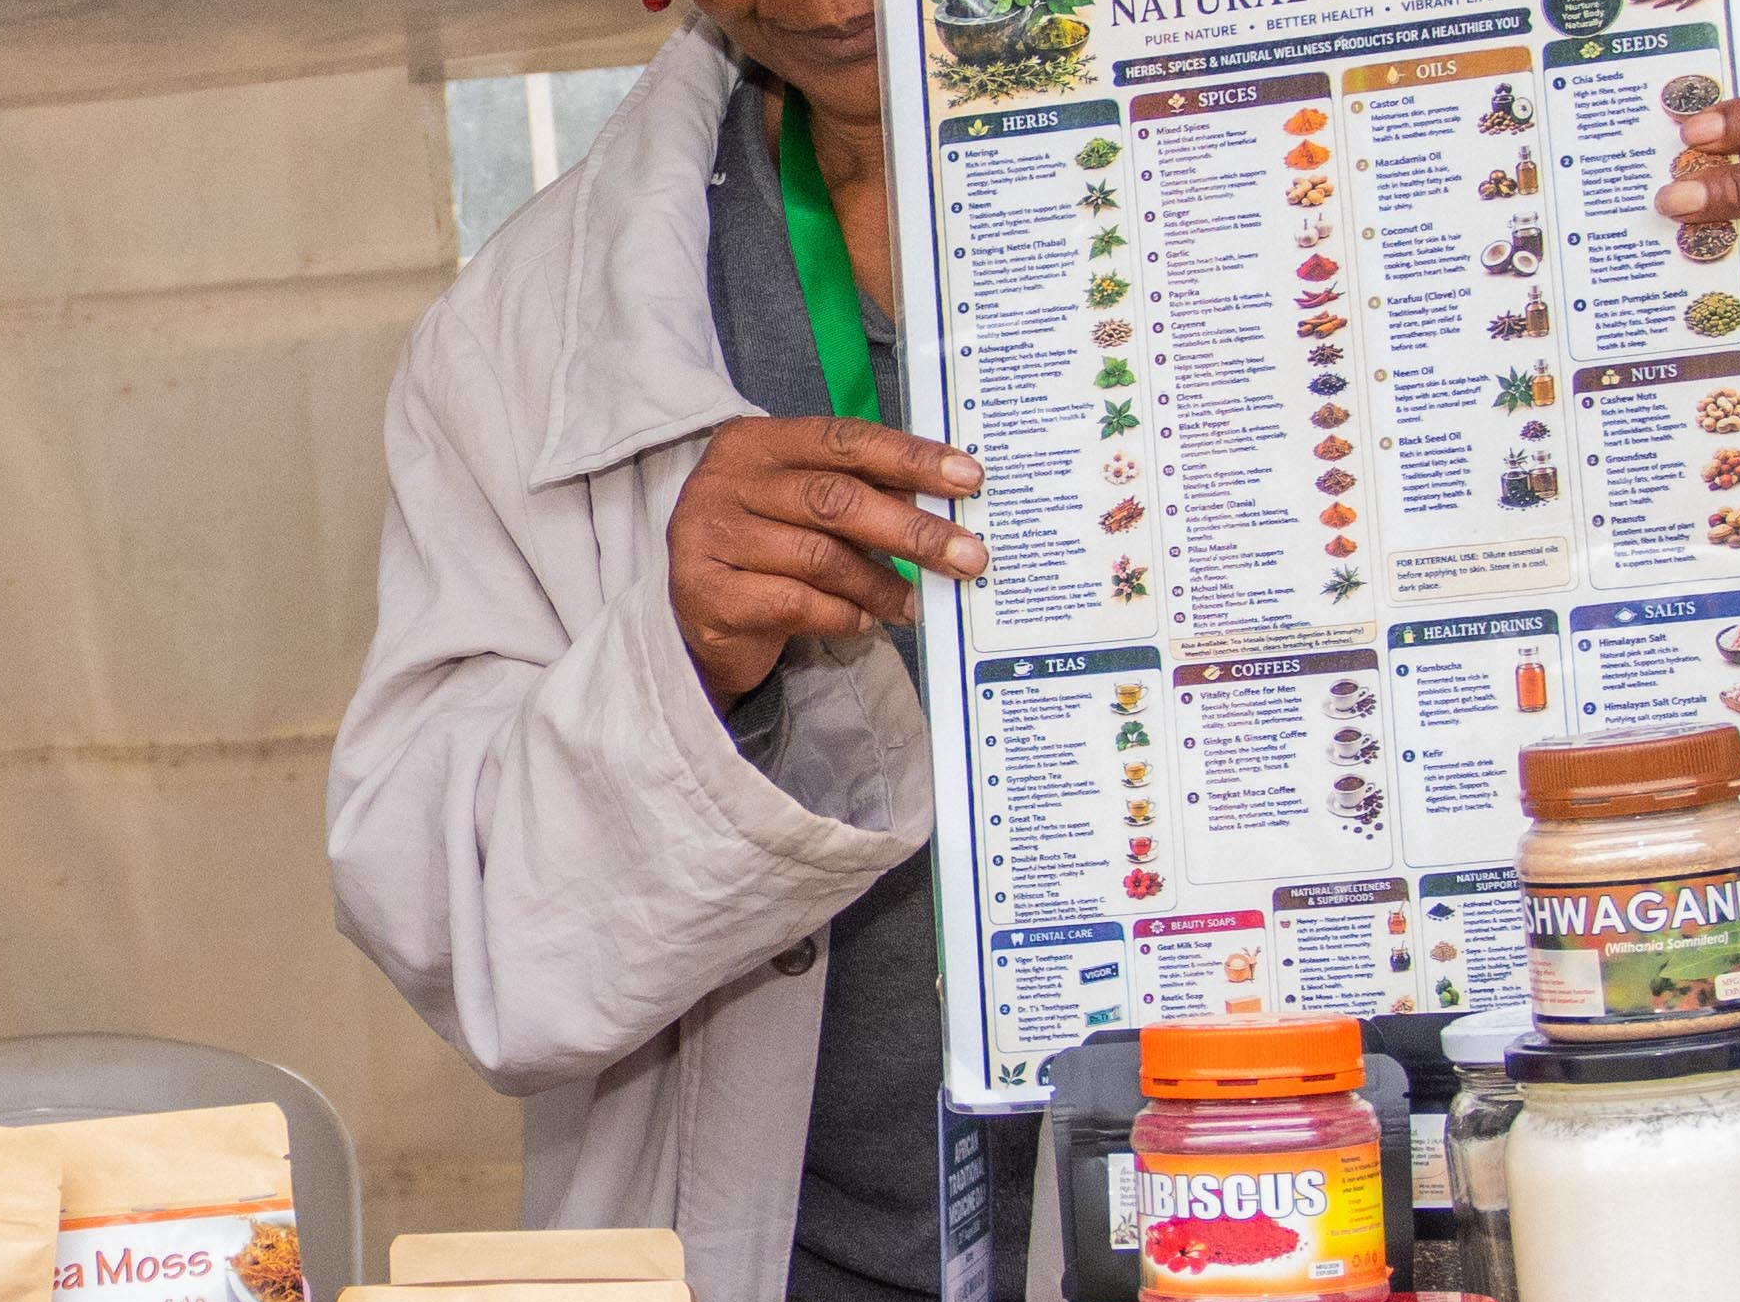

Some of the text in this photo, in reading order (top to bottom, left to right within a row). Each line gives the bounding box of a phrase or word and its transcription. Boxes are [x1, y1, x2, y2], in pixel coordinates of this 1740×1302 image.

[1561, 8, 1605, 20] Your Body
[1564, 1, 1600, 11] Nurture
[1144, 31, 1180, 46] PURE
[1184, 23, 1237, 41] NATURE
[1266, 13, 1317, 30] BETTER
[1321, 6, 1374, 23] HEALTH
[1564, 15, 1604, 29] Naturally
[1125, 15, 1519, 78] HERBS, SPICES & NATURAL WELLNESS PRODUCTS FOR A HEALTHIER YOU
[1611, 33, 1668, 53] SEEDS
[1416, 60, 1457, 78] OILS
[1571, 70, 1624, 85] Chia Seeds
[1198, 85, 1257, 107] SPICES
[1369, 95, 1414, 109] Castor Oil
[1002, 110, 1058, 131] HERBS
[1375, 151, 1441, 167] Macadamia Oil
[1380, 222, 1433, 236] Coconut Oil
[1386, 287, 1471, 305] Karafuu (Clove) Oil
[1630, 363, 1677, 381] NUTS
[1642, 600, 1695, 618] SALTS
[1423, 616, 1543, 639] HEALTHY DRINKS
[1045, 656, 1086, 672] TEAS
[1230, 659, 1300, 677] COFFEES
[1290, 881, 1391, 899] NATURAL SWEETENERS
[1475, 879, 1518, 891] SUPPORT
[1316, 889, 1375, 905] SUPERFOODS
[1169, 916, 1236, 932] BEAUTY SOAPS
[1029, 928, 1093, 942] DENTAL CARE
[1605, 931, 1729, 956] (Withania Somnifera)
[95, 1247, 212, 1286] Moss
